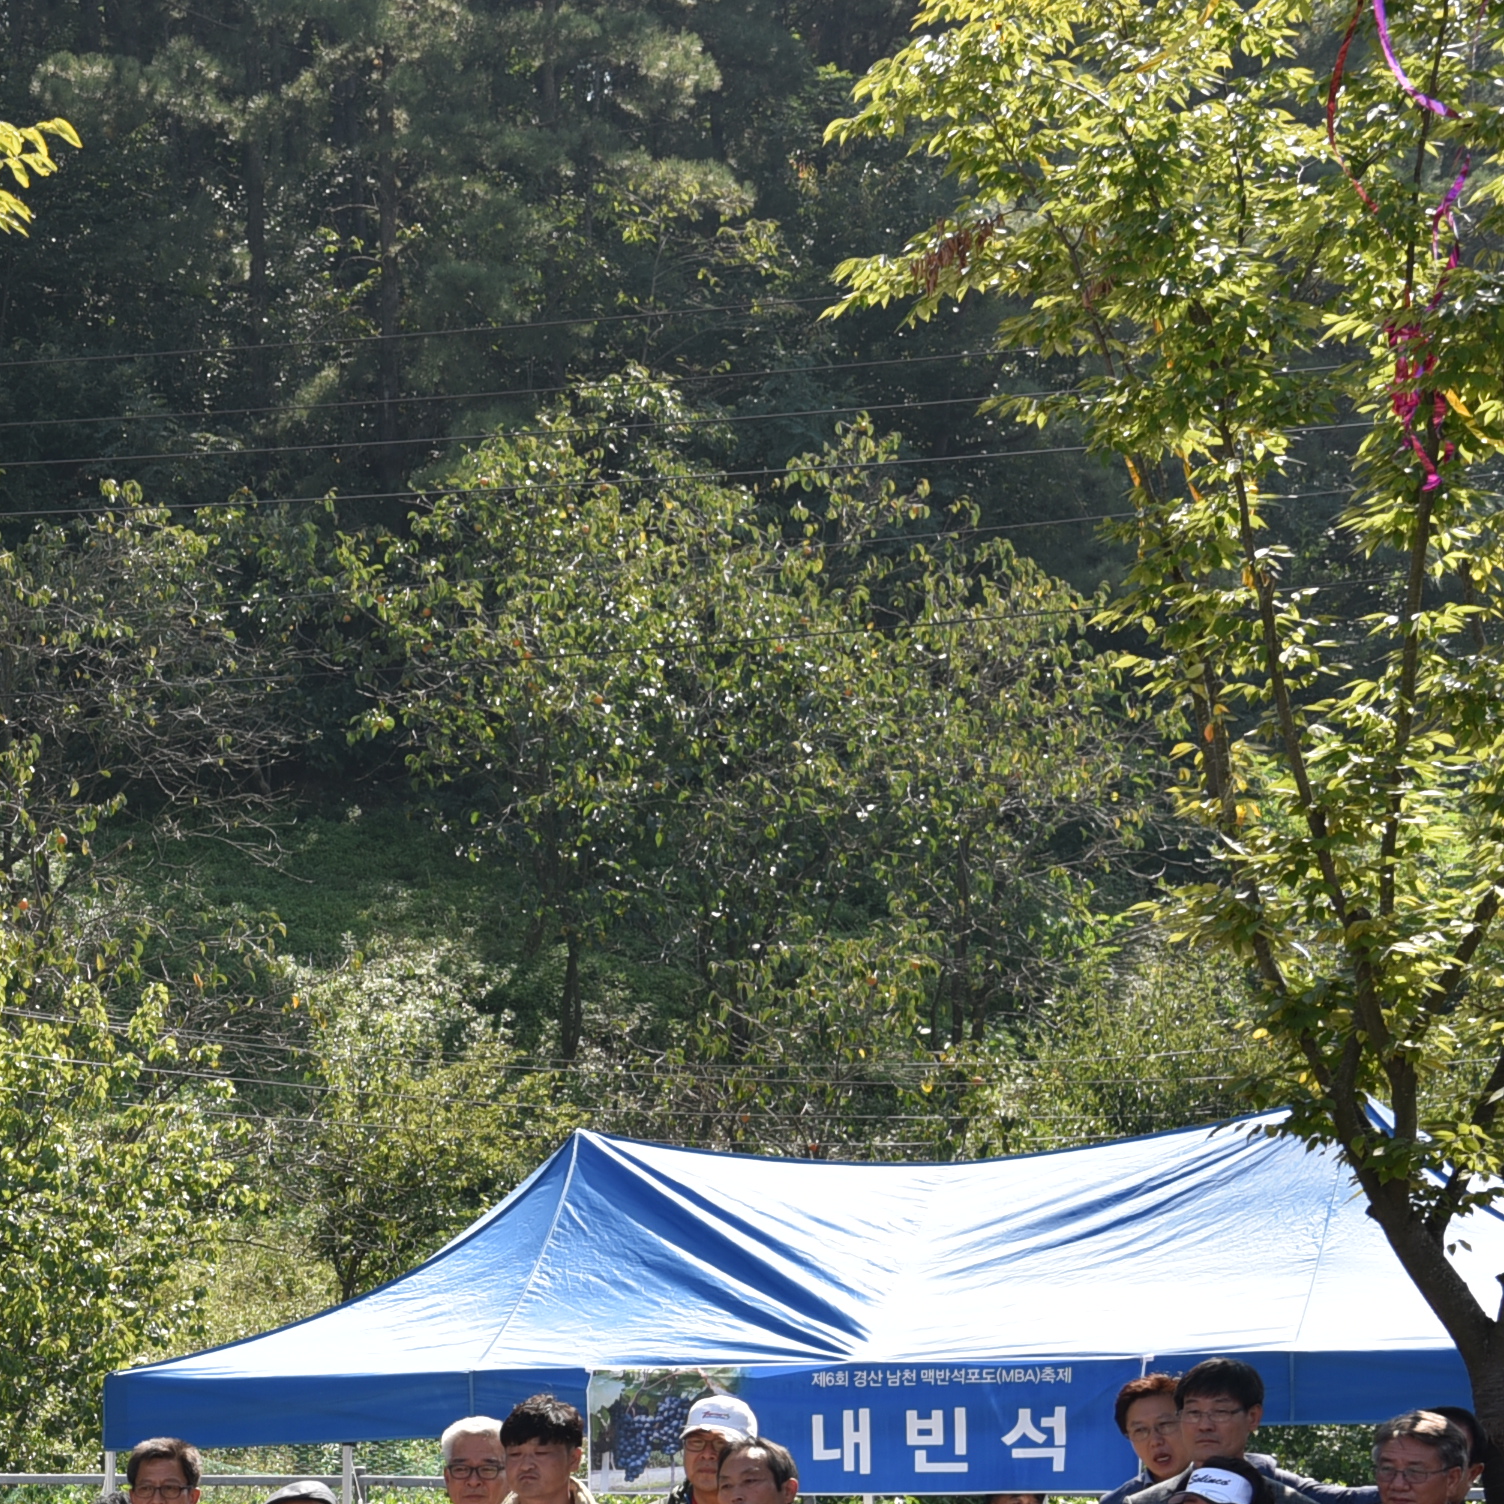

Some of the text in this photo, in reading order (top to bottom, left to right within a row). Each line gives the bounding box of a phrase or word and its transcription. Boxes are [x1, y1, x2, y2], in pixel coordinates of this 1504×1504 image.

[811, 1371, 849, 1387] 제6회
[853, 1370, 883, 1386] 경산
[886, 1369, 916, 1386] 남천
